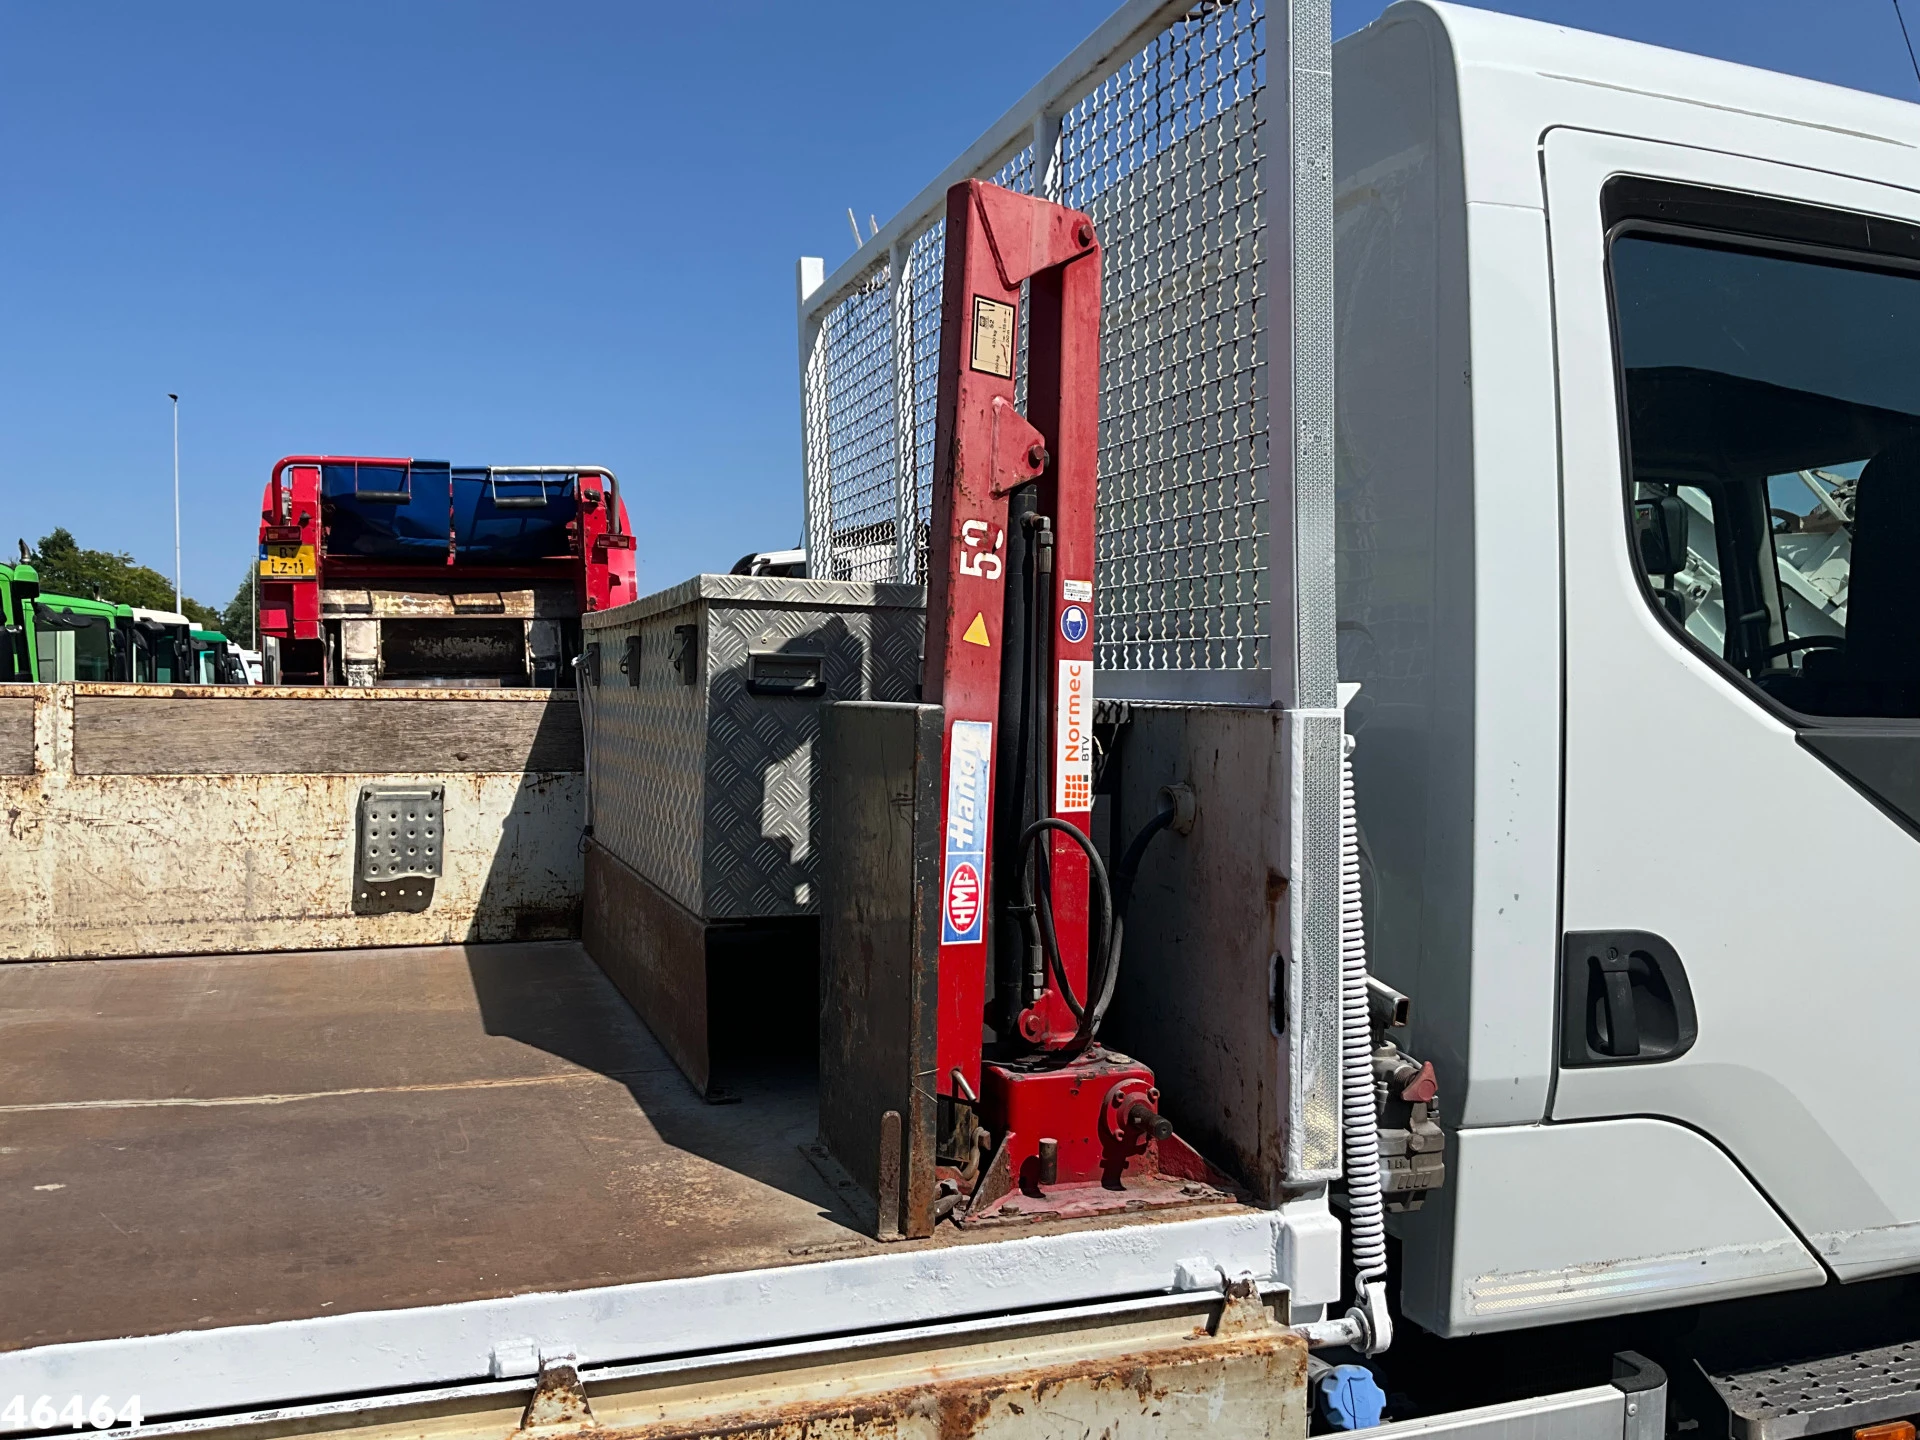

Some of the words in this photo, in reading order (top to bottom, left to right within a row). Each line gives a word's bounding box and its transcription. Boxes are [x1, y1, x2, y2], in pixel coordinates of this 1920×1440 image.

[1064, 664, 1082, 762] Normec
[1081, 735, 1090, 762] BTV
[949, 727, 989, 849] Handy
[951, 871, 977, 925] HMF
